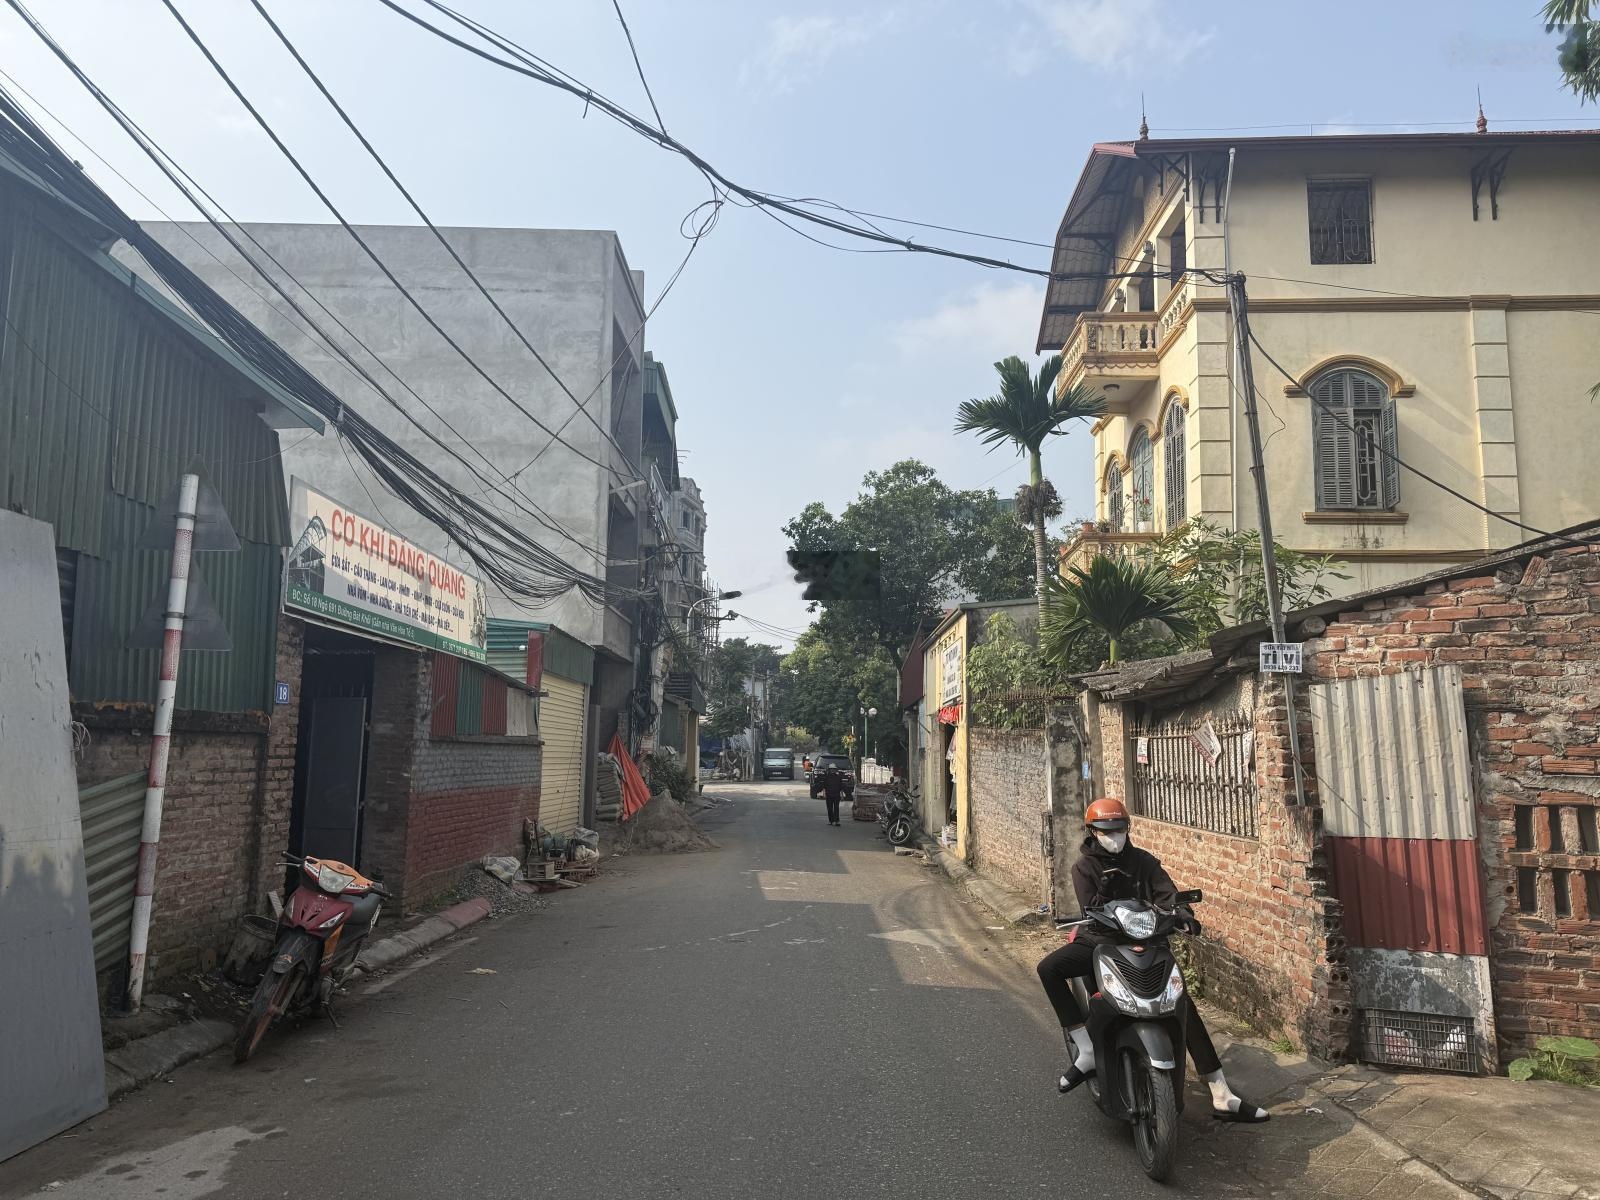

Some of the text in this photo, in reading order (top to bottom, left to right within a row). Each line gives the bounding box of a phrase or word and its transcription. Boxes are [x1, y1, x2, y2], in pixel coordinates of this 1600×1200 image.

[332, 509, 355, 547] CƠ
[360, 523, 385, 562] KHÍ
[428, 560, 466, 600] QUANG
[280, 686, 287, 700] 18
